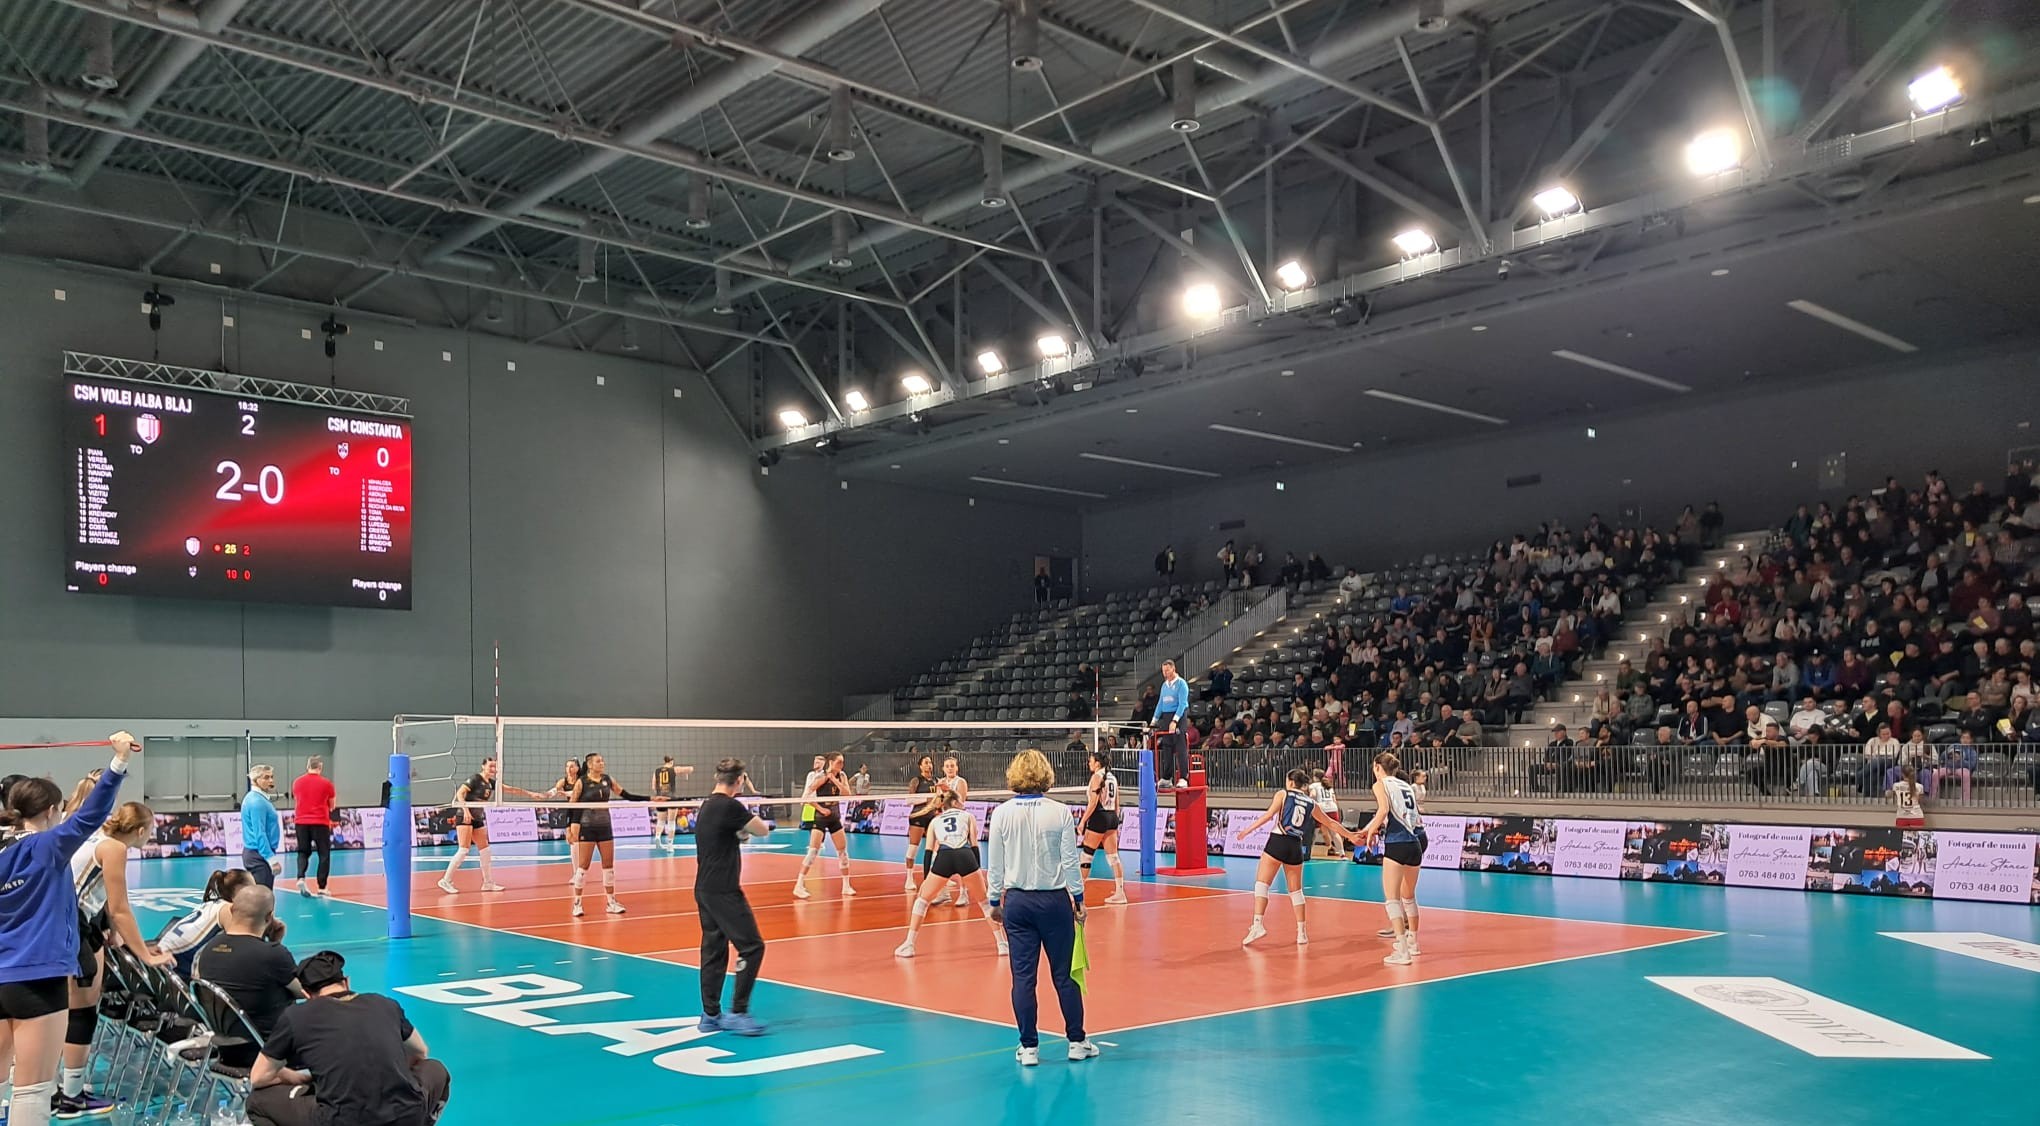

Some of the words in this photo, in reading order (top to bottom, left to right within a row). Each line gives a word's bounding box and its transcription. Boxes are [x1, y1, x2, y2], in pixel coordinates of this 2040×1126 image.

[74, 384, 98, 402] CSM
[101, 387, 132, 406] VOLEI
[134, 391, 162, 410] ALBA
[165, 395, 192, 413] BLAJ
[95, 413, 106, 436] 1
[242, 414, 255, 435] 2
[328, 417, 348, 432] CSM
[350, 420, 402, 440] CONSTANTA
[130, 444, 143, 455] TO
[376, 448, 390, 468] 0
[329, 466, 340, 476] TO
[216, 460, 284, 504] 2-0
[244, 546, 250, 556] 2
[75, 561, 106, 572] Players
[108, 564, 136, 575] change
[244, 570, 250, 580] 0
[98, 573, 108, 585] 0
[352, 578, 377, 590] Players
[378, 580, 402, 592] change
[379, 590, 386, 600] 0
[660, 771, 669, 786] 10
[1109, 782, 1114, 798] 9
[1401, 790, 1414, 810] 5
[1900, 792, 1912, 806] 13
[1292, 804, 1306, 827] 6
[944, 816, 957, 832] 3
[1738, 832, 1770, 841] Fotograf
[1948, 840, 1988, 849] Fotograf
[1762, 871, 1777, 879] 484
[1780, 872, 1796, 880] 803
[1950, 882, 1974, 890] 0763
[2000, 884, 2019, 893] 803
[393, 974, 885, 1077] BLAJ
